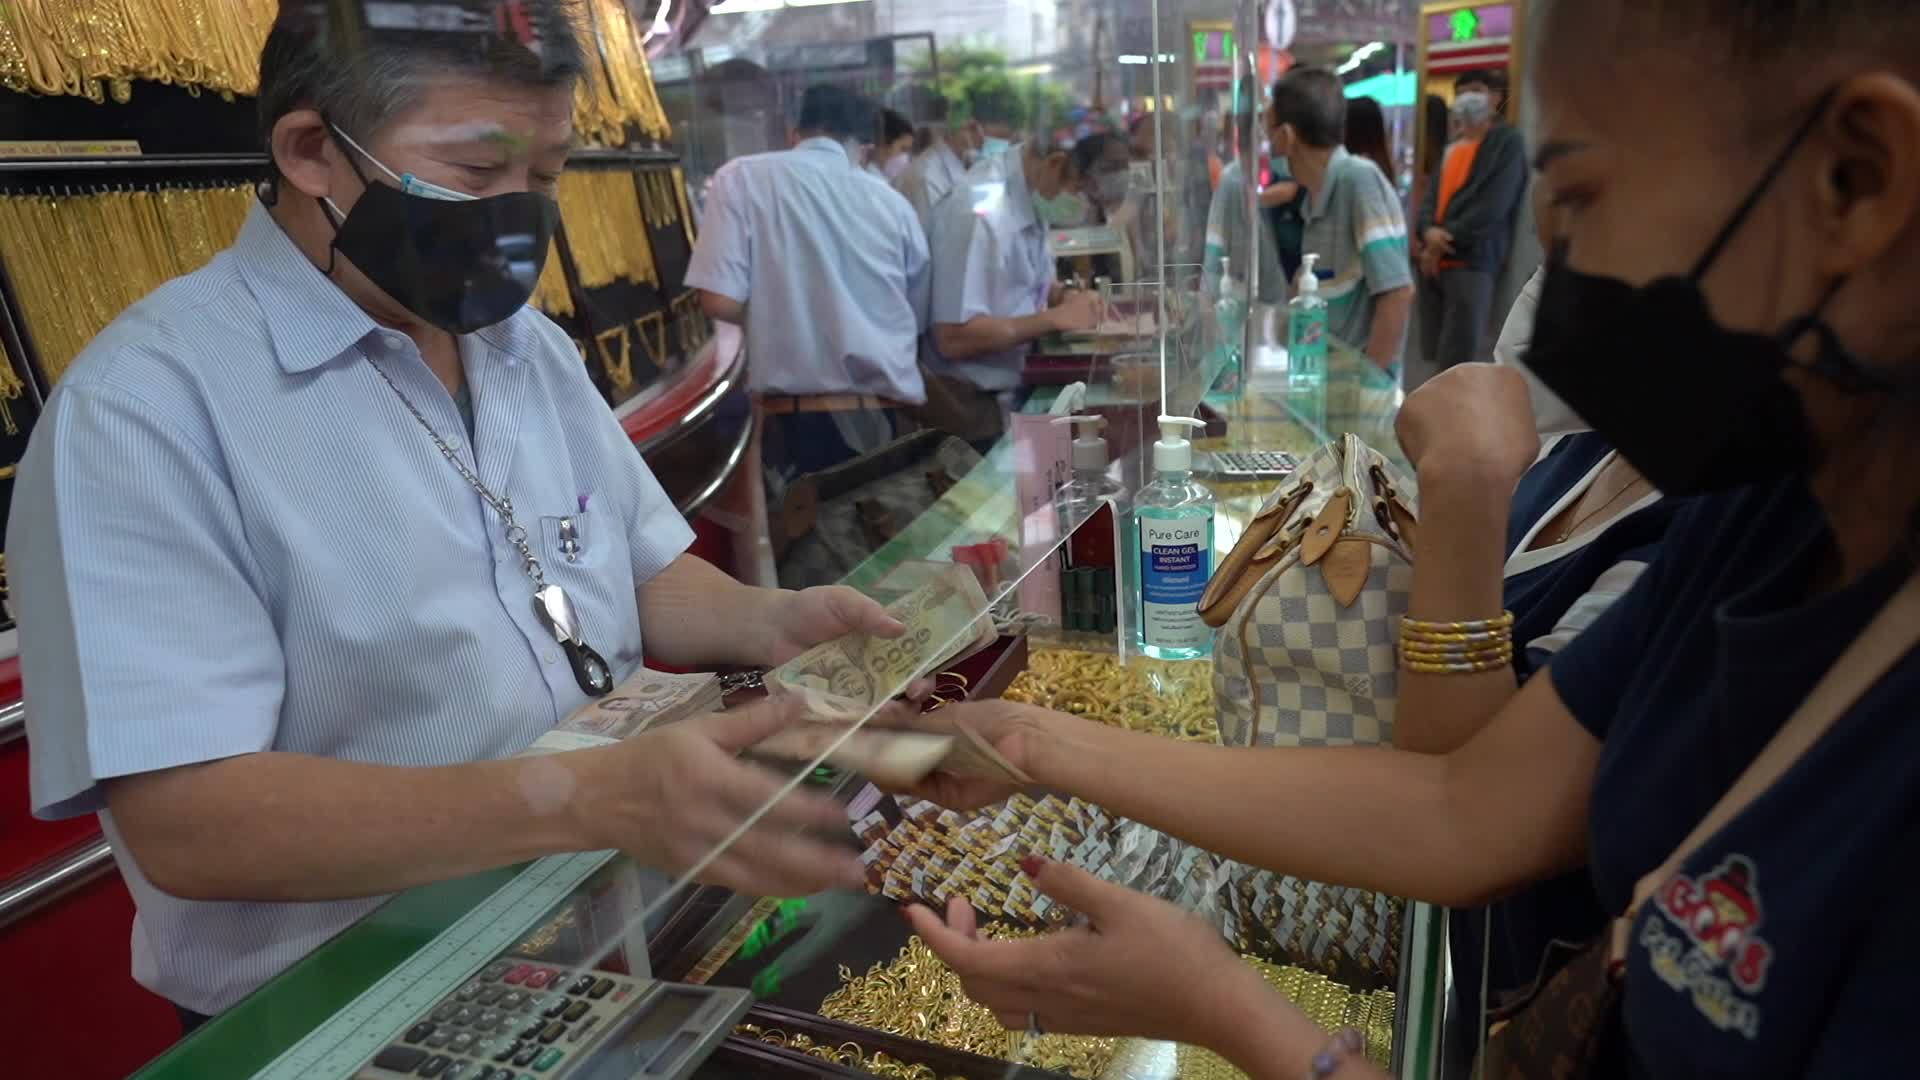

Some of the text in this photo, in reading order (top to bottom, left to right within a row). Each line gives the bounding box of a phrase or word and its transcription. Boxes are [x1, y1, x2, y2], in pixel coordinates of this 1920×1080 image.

[1149, 528, 1200, 540] Pure Care
[1153, 546, 1196, 555] CLEAN GEL
[1159, 556, 1191, 564] INSTANT
